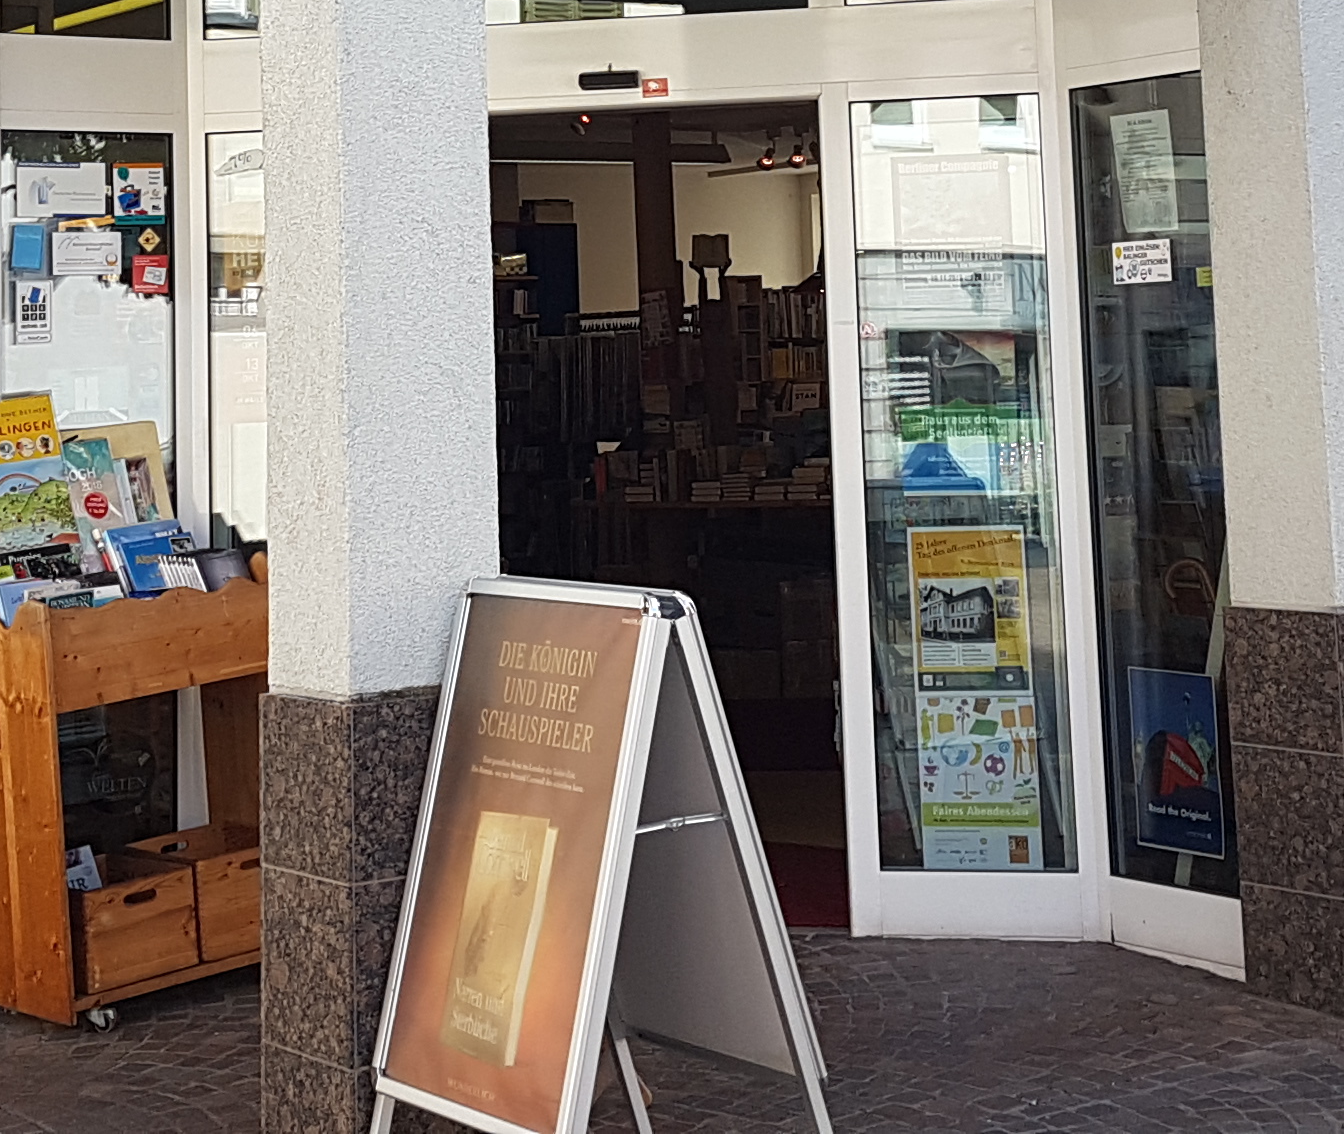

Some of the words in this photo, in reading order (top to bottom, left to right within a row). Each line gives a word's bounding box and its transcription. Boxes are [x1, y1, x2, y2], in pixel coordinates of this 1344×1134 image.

[499, 641, 526, 670] DIE
[529, 639, 598, 678] KÖNIGIN
[503, 676, 537, 706] UND
[540, 681, 580, 714] IHRE
[478, 708, 594, 753] SCHAUSPIELER
